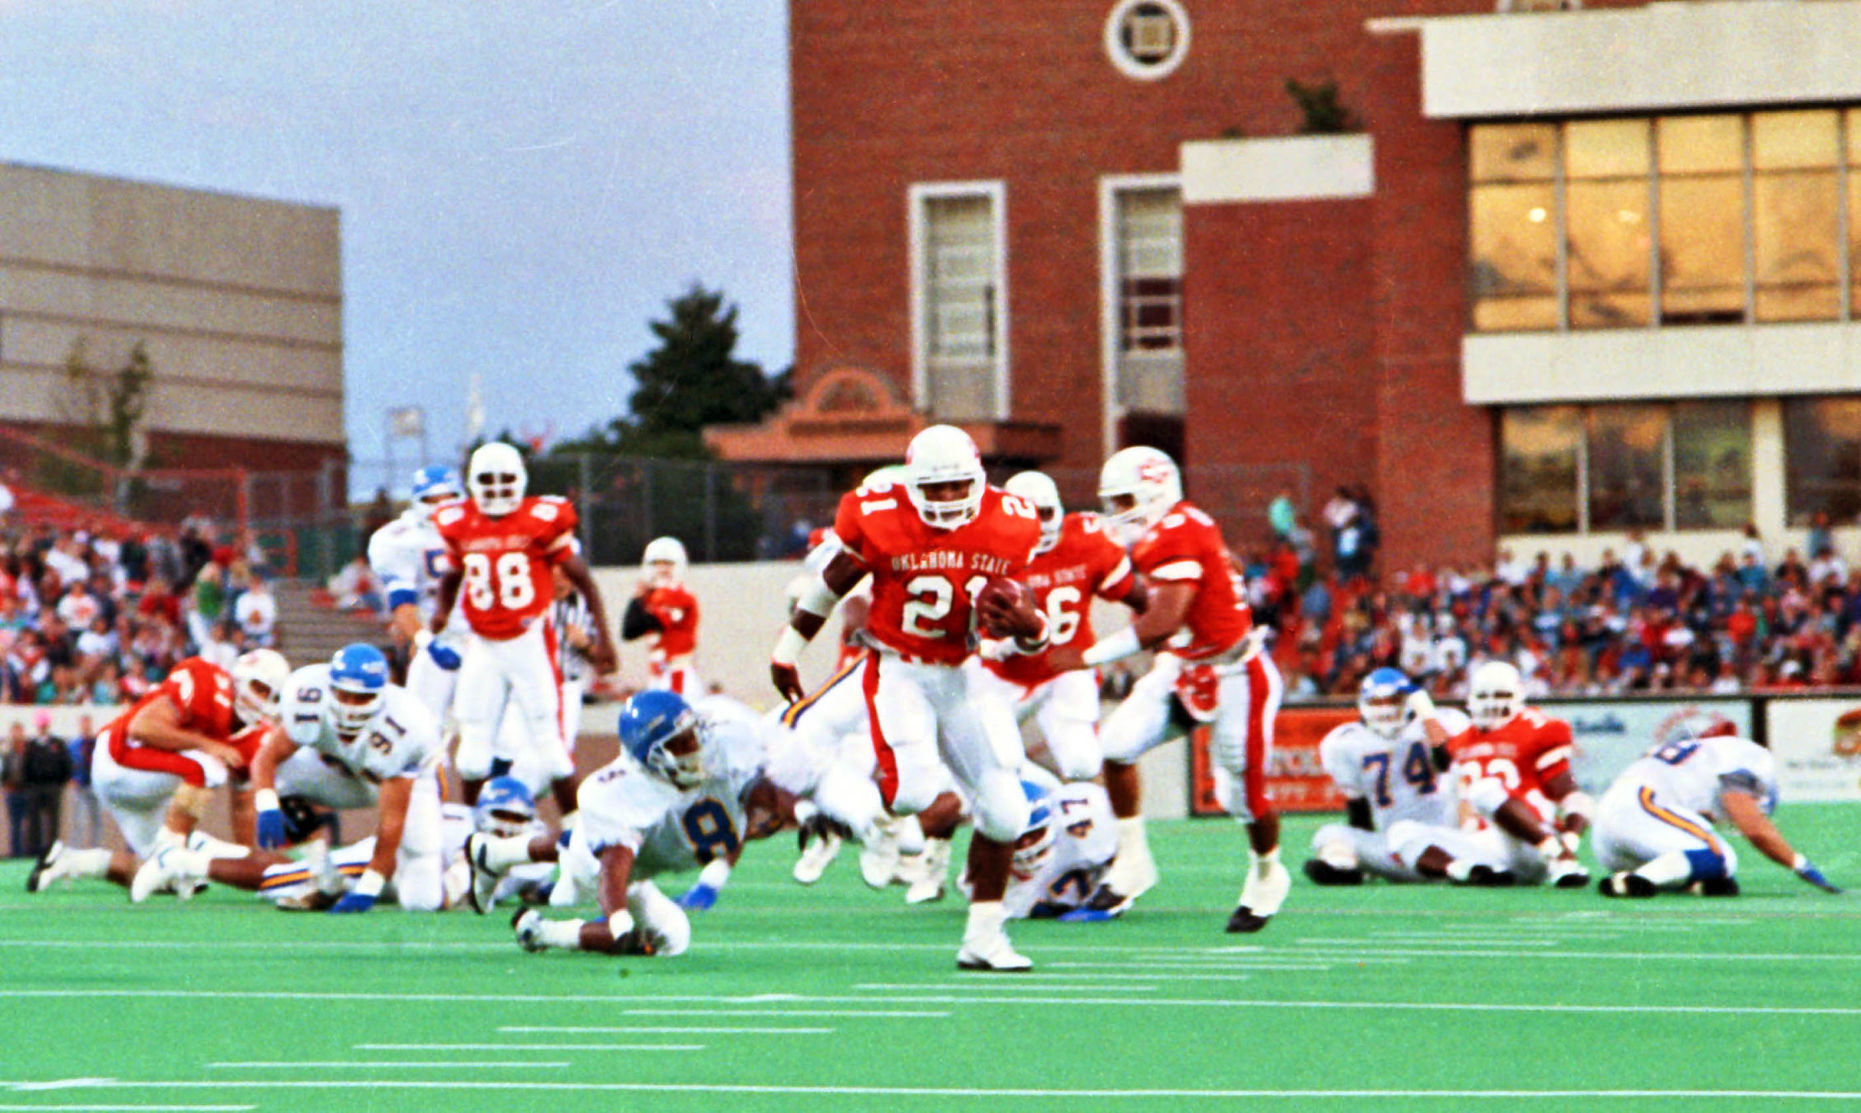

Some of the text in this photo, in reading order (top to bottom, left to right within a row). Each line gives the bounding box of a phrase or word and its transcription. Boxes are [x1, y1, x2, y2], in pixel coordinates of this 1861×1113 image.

[463, 552, 535, 611] 88
[892, 550, 1012, 576] OKLAHOMA STATE
[295, 687, 322, 723] 91
[369, 714, 407, 756] 91
[1362, 741, 1437, 808] 74
[1060, 798, 1094, 839] 47
